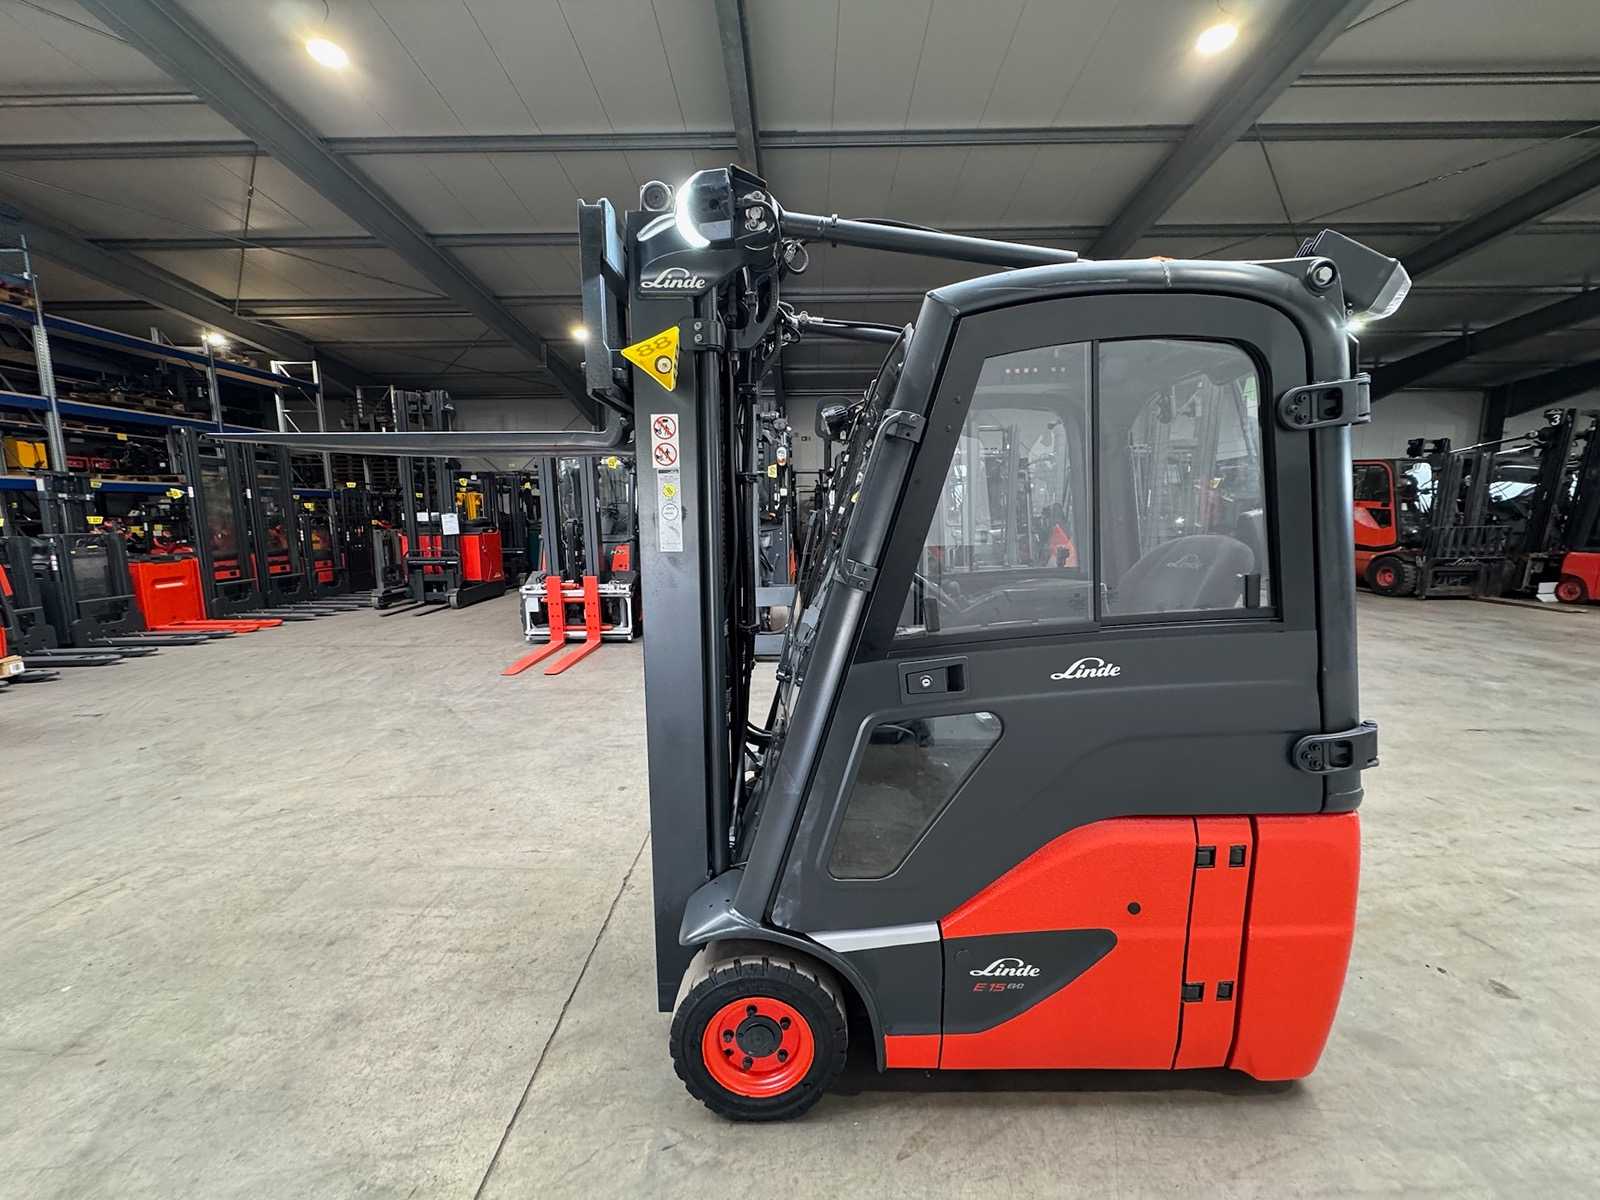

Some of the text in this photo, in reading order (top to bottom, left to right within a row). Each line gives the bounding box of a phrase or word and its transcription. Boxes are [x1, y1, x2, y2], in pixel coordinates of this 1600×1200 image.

[640, 267, 706, 289] Linde
[1551, 414, 1561, 426] 3
[1050, 657, 1121, 680] Linde
[969, 957, 1041, 977] Linde
